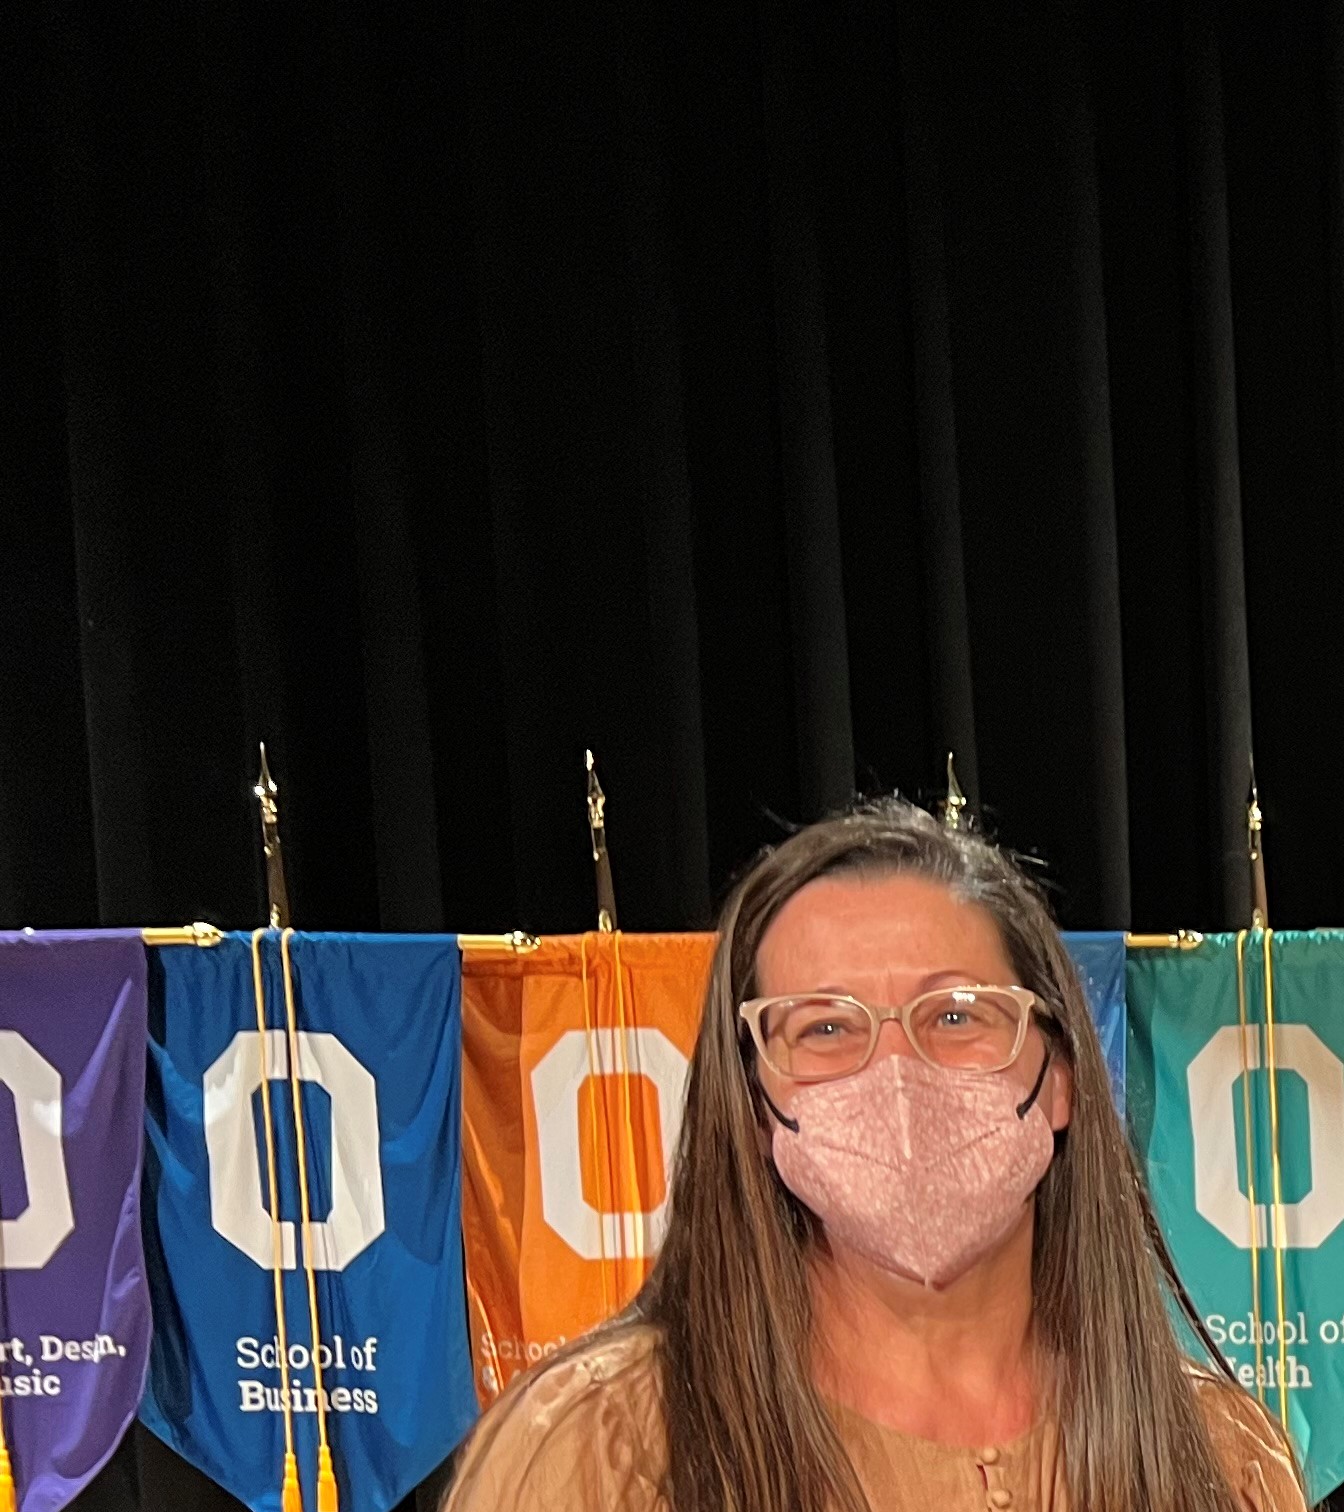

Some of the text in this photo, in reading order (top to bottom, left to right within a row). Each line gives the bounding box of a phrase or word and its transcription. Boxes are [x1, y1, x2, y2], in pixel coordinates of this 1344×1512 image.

[1206, 1312, 1309, 1345] School
[236, 1335, 378, 1371] School of
[238, 1379, 379, 1414] Business
